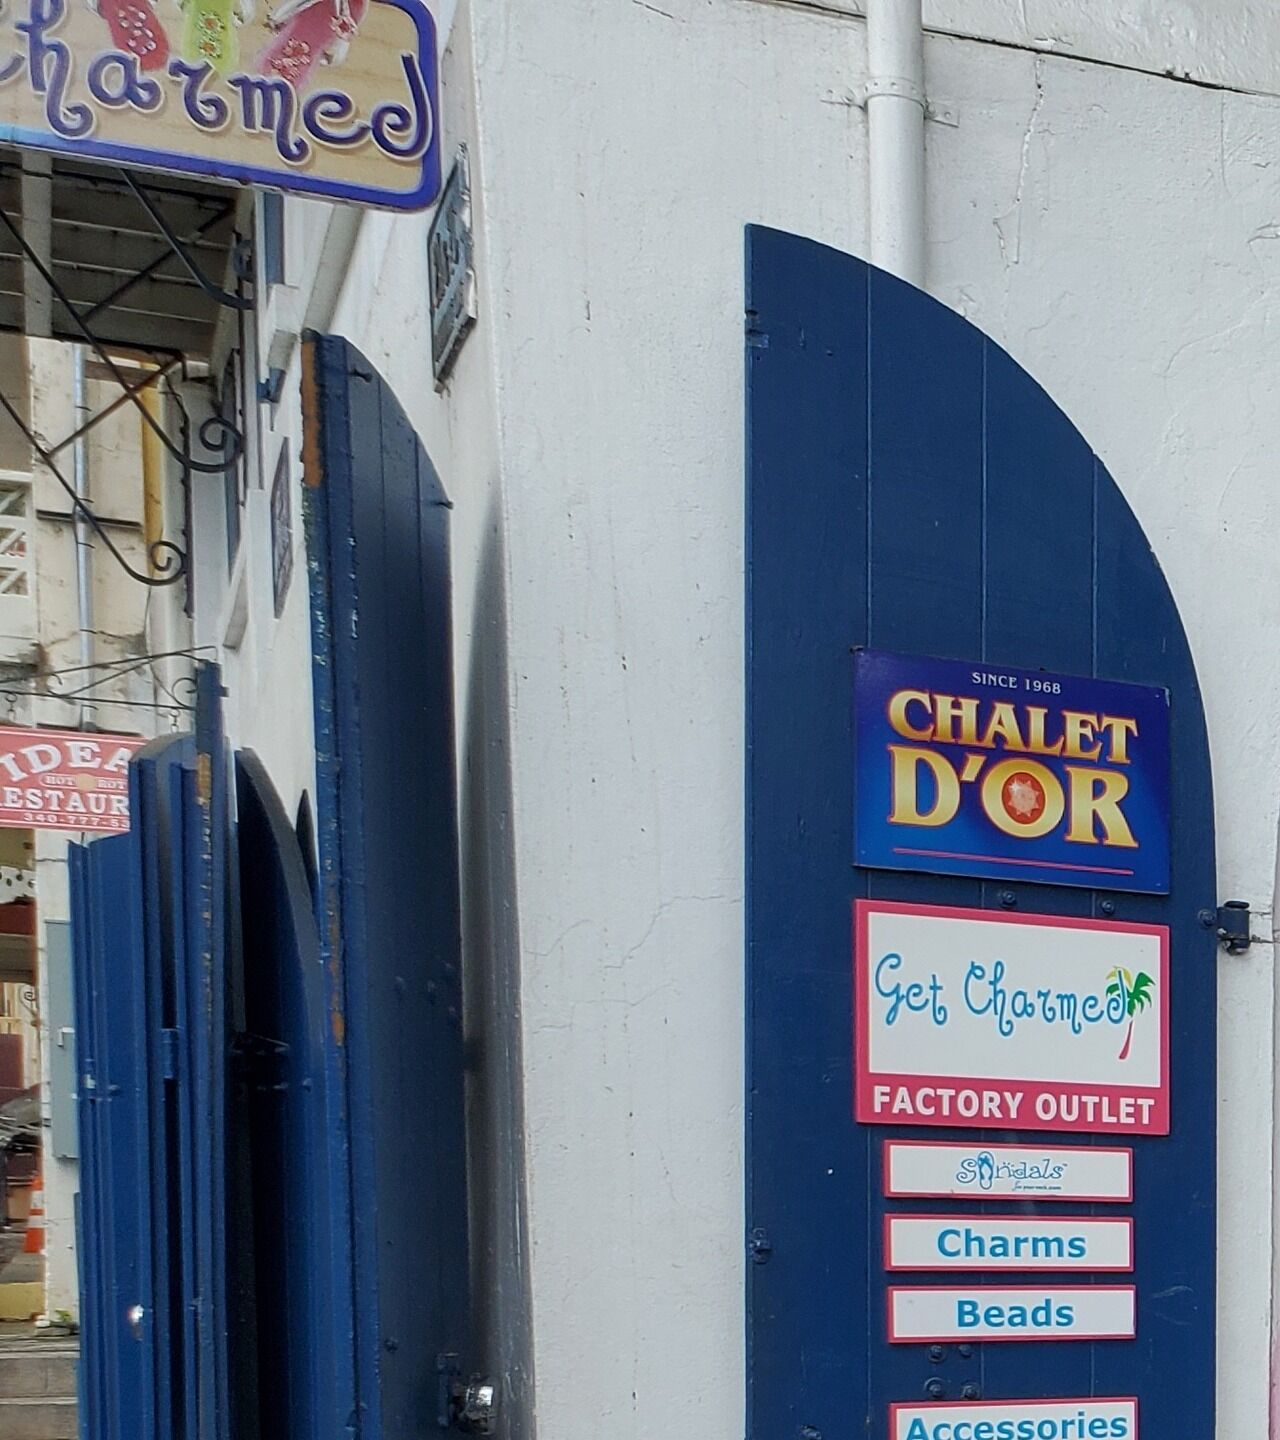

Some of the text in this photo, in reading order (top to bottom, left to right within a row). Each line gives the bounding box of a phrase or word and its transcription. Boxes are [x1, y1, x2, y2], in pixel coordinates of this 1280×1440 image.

[0, 0, 432, 165] harmed
[972, 671, 1062, 695] SINCE 1968
[887, 689, 1139, 765] CHALET
[0, 787, 130, 816] ESTAUR
[888, 743, 1139, 848] D'OR
[874, 952, 1130, 1037] Get Charmed
[873, 1085, 1155, 1125] FACTORY OUTLET
[937, 1228, 1087, 1259] Charms
[957, 1298, 1075, 1328] Beads
